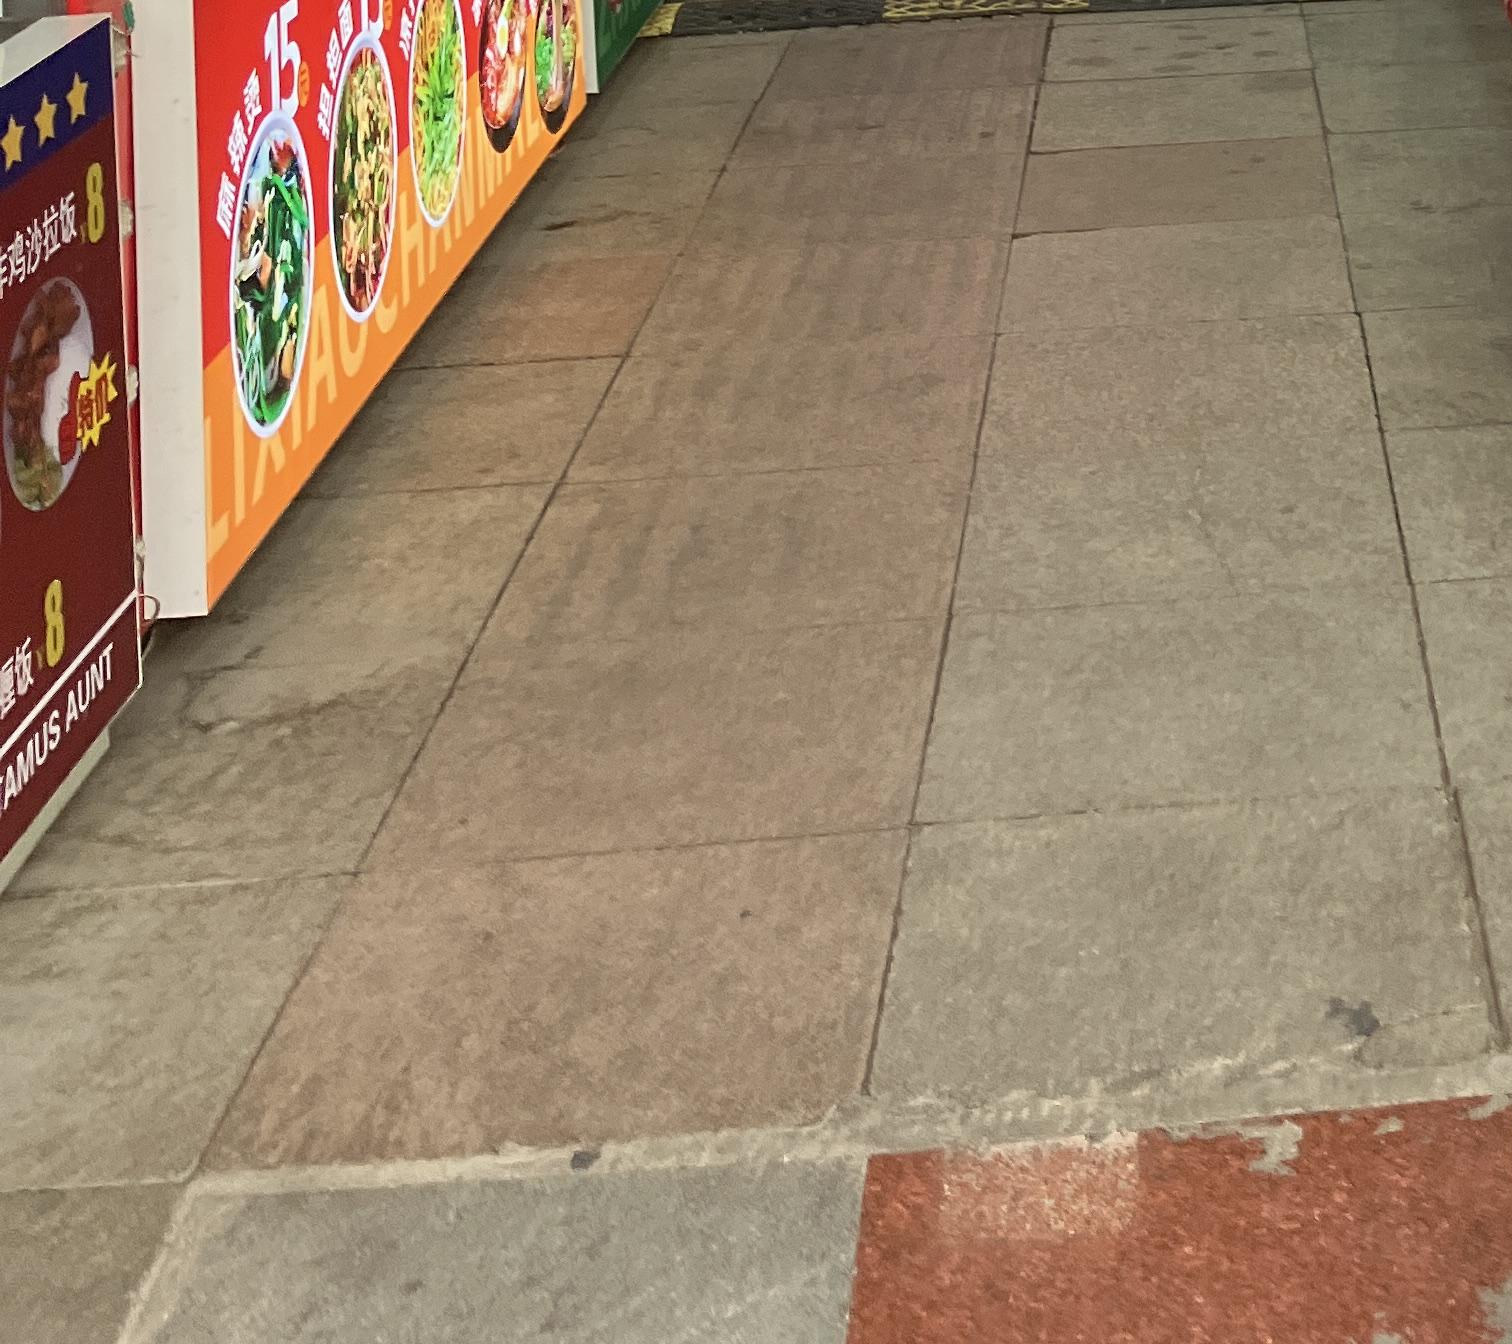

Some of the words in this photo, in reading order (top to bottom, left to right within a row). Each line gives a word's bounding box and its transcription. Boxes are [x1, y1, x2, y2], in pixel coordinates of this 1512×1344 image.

[214, 67, 263, 239] 麻辣烫
[65, 641, 115, 734] AUNT
